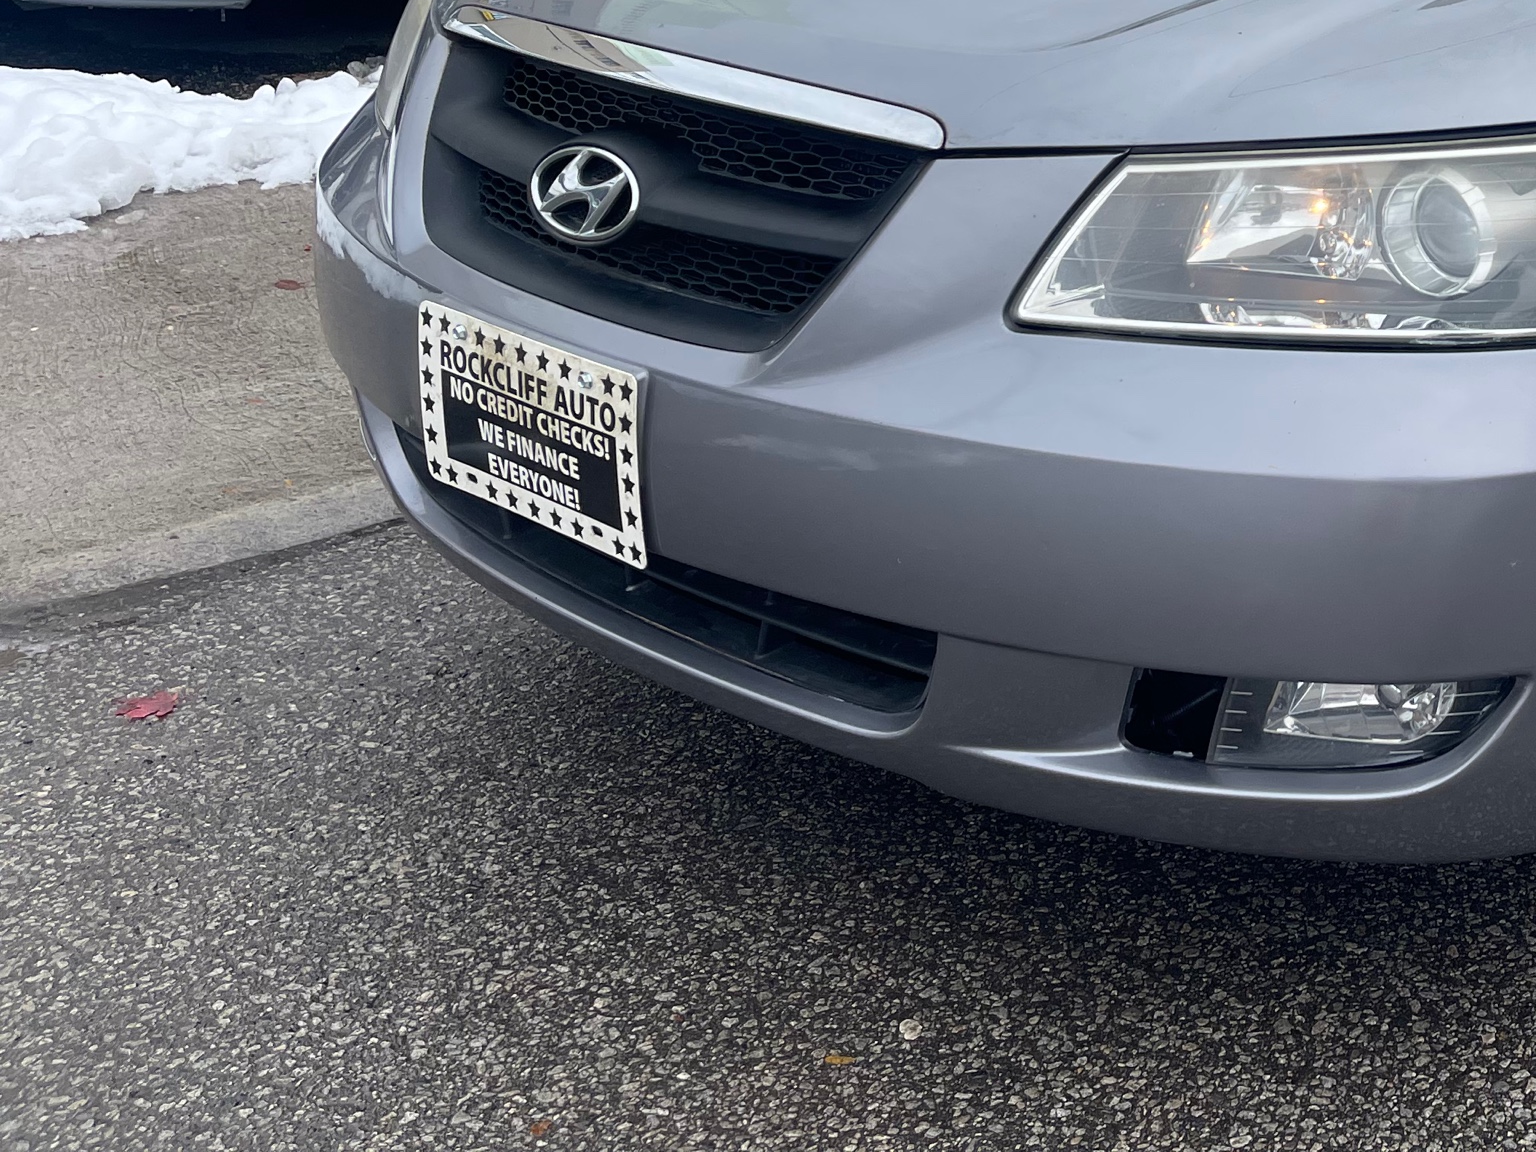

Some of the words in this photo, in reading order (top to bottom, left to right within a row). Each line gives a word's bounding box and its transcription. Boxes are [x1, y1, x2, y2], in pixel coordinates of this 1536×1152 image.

[440, 339, 547, 407] ROCKCLIFF
[554, 385, 616, 432] AUTO
[450, 376, 475, 405] NO
[476, 385, 533, 430] CREDIT
[537, 412, 610, 460] CHECKS!
[478, 418, 504, 448] WE
[507, 430, 580, 480] FINANCE
[488, 452, 581, 511] EVERYONE!
